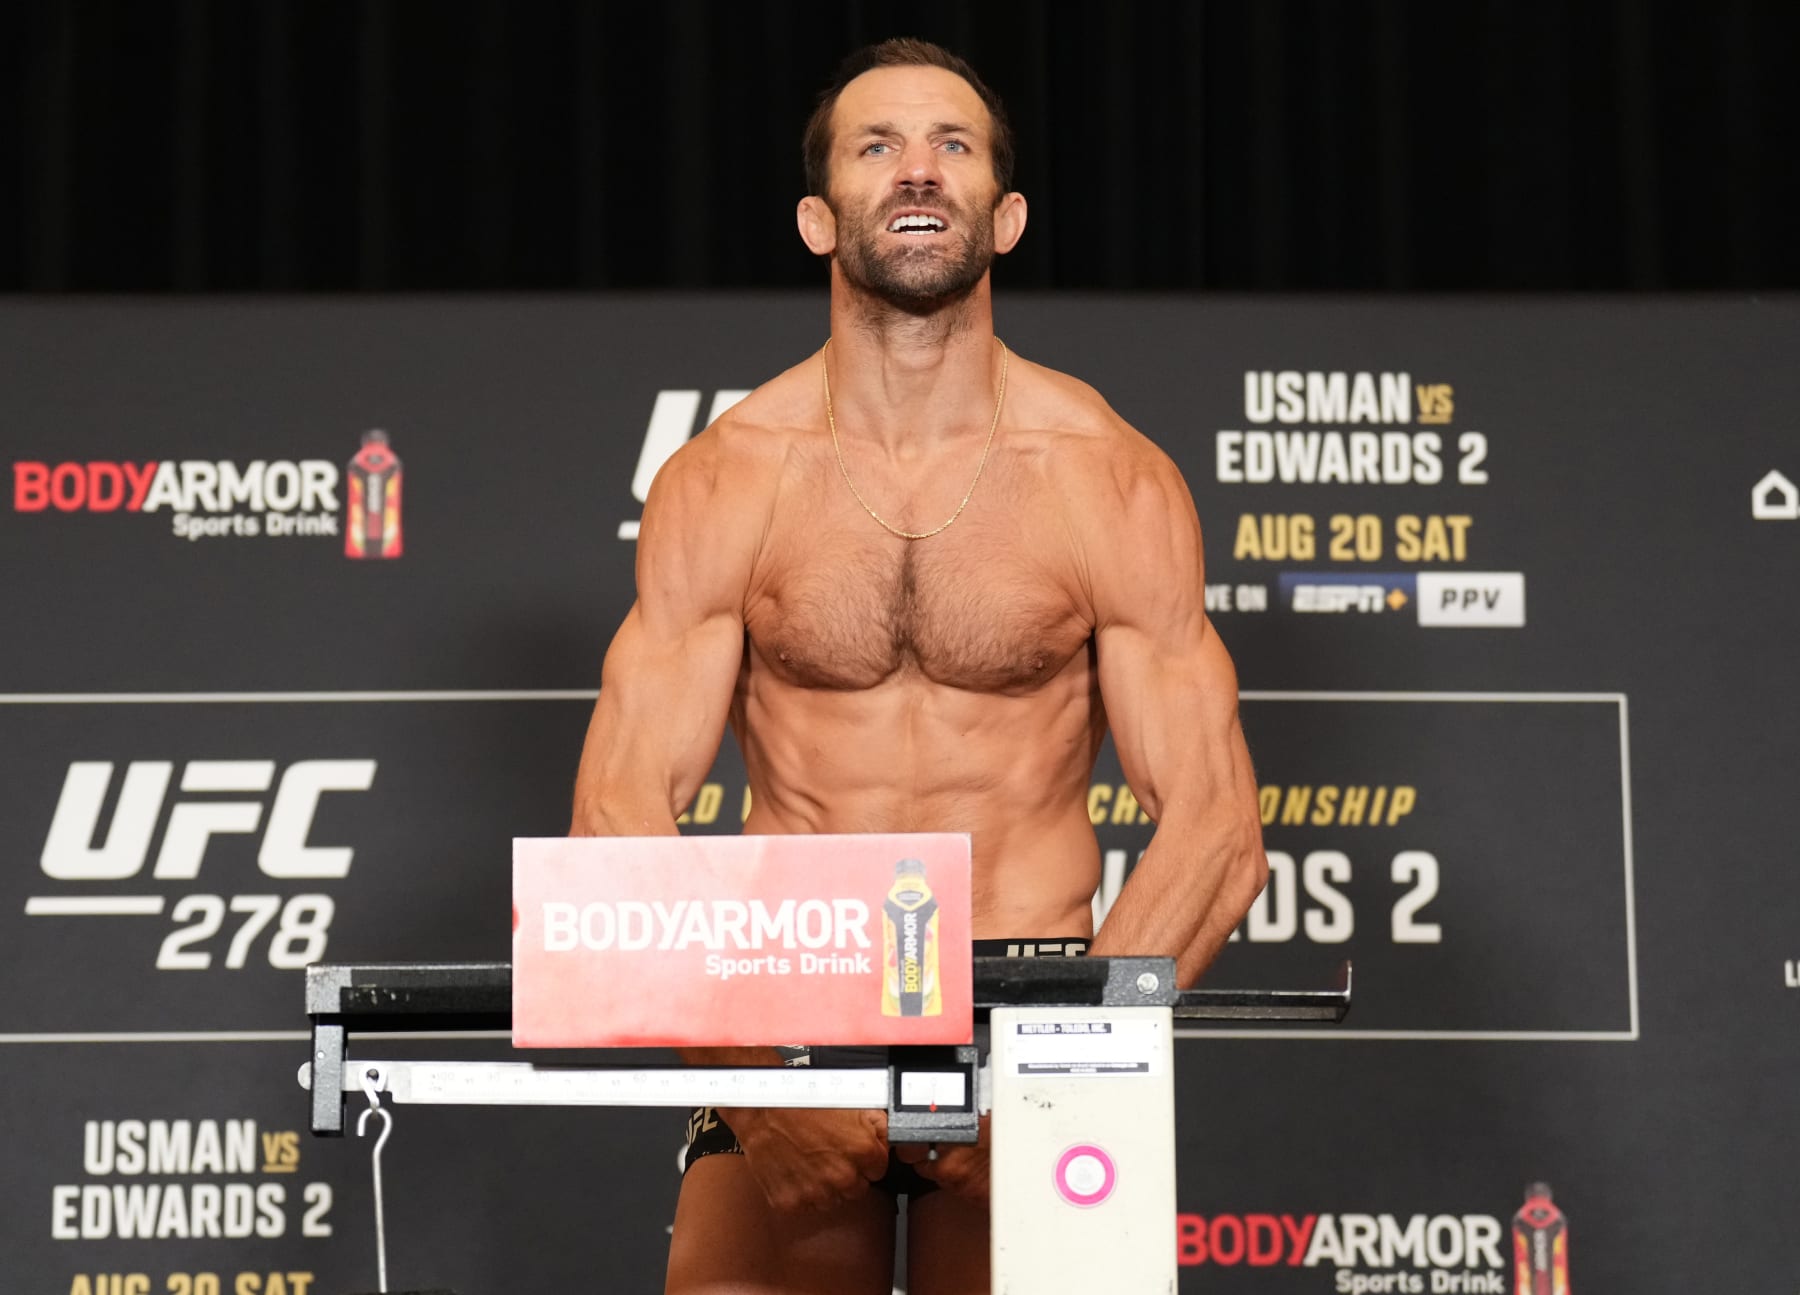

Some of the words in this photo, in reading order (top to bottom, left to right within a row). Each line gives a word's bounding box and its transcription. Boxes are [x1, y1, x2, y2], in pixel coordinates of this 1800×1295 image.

[1244, 371, 1411, 424] USMAN
[1416, 384, 1454, 424] VS
[1216, 431, 1443, 485] EDWARDS
[1458, 432, 1488, 485] 2
[13, 460, 340, 513] BODYARMOR
[173, 513, 260, 541] Sports
[266, 513, 338, 536] Drink
[1234, 514, 1315, 561] AUG
[1329, 514, 1382, 561] 20
[1395, 515, 1472, 562] SAT
[1205, 584, 1231, 612] VE
[1236, 584, 1267, 612] ON
[1440, 588, 1500, 611] PPV
[40, 759, 377, 880] UFC
[1391, 851, 1442, 943] 2
[155, 894, 335, 969] 278
[543, 899, 871, 951] BODYARMOR
[705, 953, 791, 979] Sports
[800, 952, 871, 975] Drink
[904, 912, 918, 993] BODYARMOR
[84, 1119, 256, 1175] USMAN
[262, 1131, 299, 1173] VS
[52, 1183, 286, 1239] EDWARDS
[302, 1183, 332, 1237] 2
[1177, 1214, 1504, 1268] BODYARMOR
[1336, 1268, 1424, 1295] Sports
[1431, 1268, 1504, 1295] Drink
